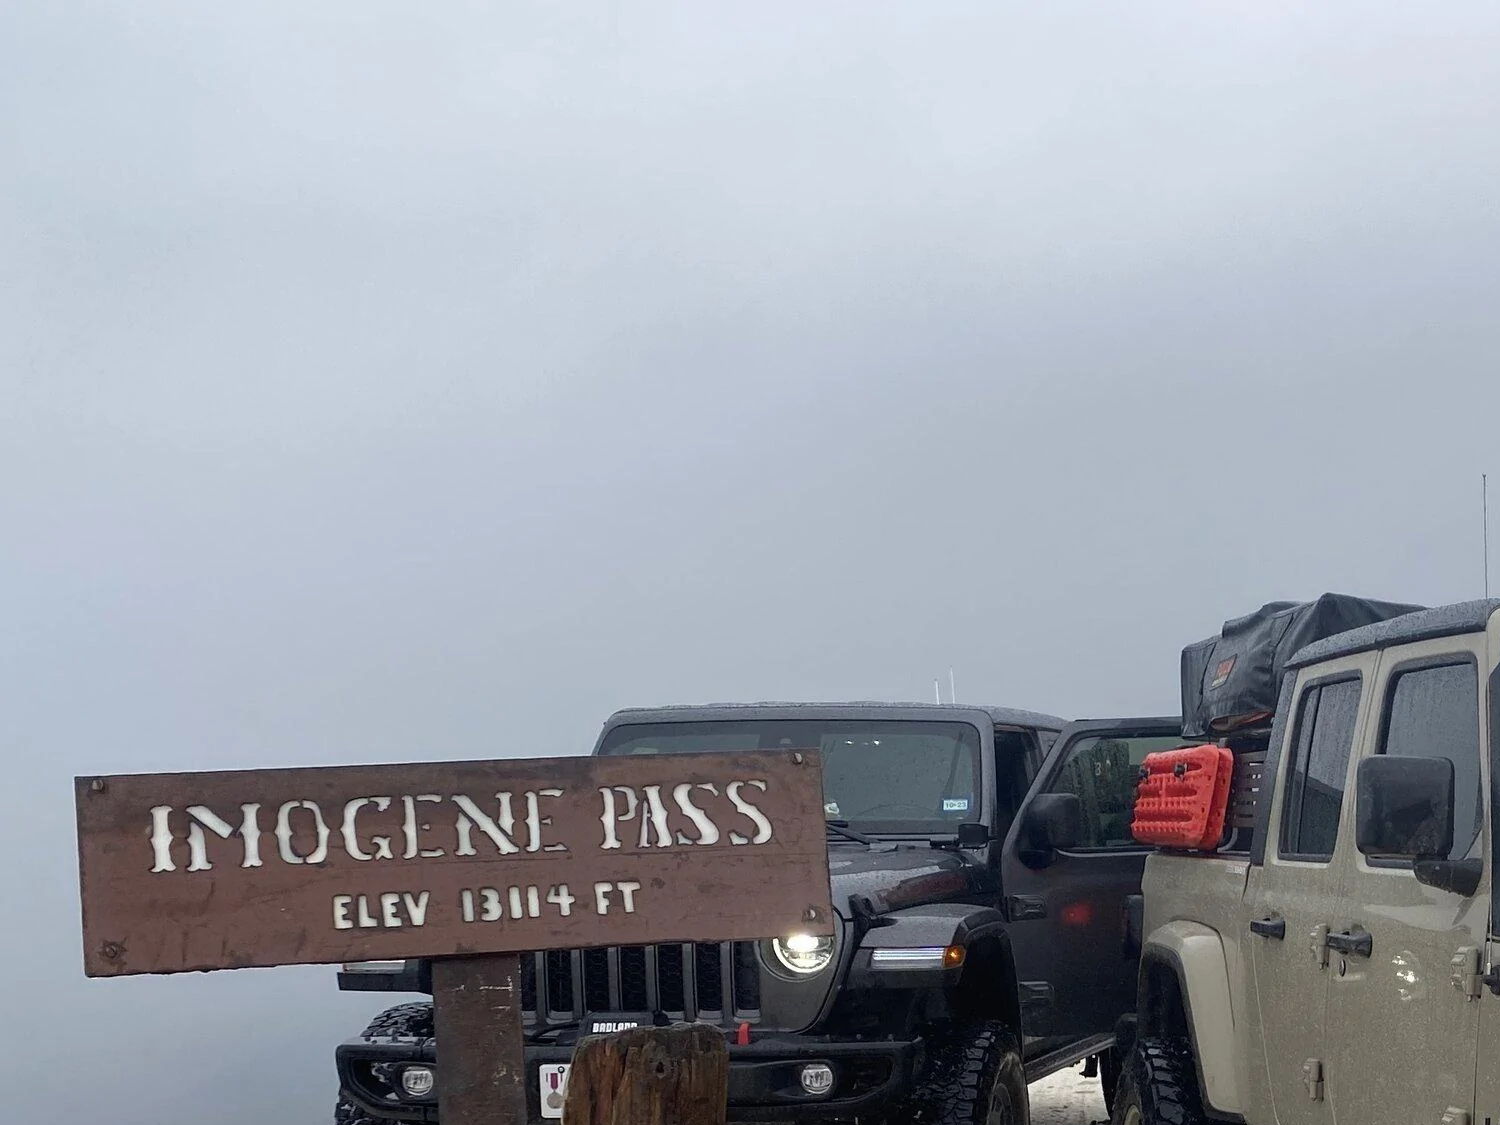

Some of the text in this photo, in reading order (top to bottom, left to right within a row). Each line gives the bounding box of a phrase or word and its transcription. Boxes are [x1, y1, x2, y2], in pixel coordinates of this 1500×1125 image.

[150, 779, 773, 872] IMOGENE PASS
[333, 881, 641, 929] ELEV 13114 FT
